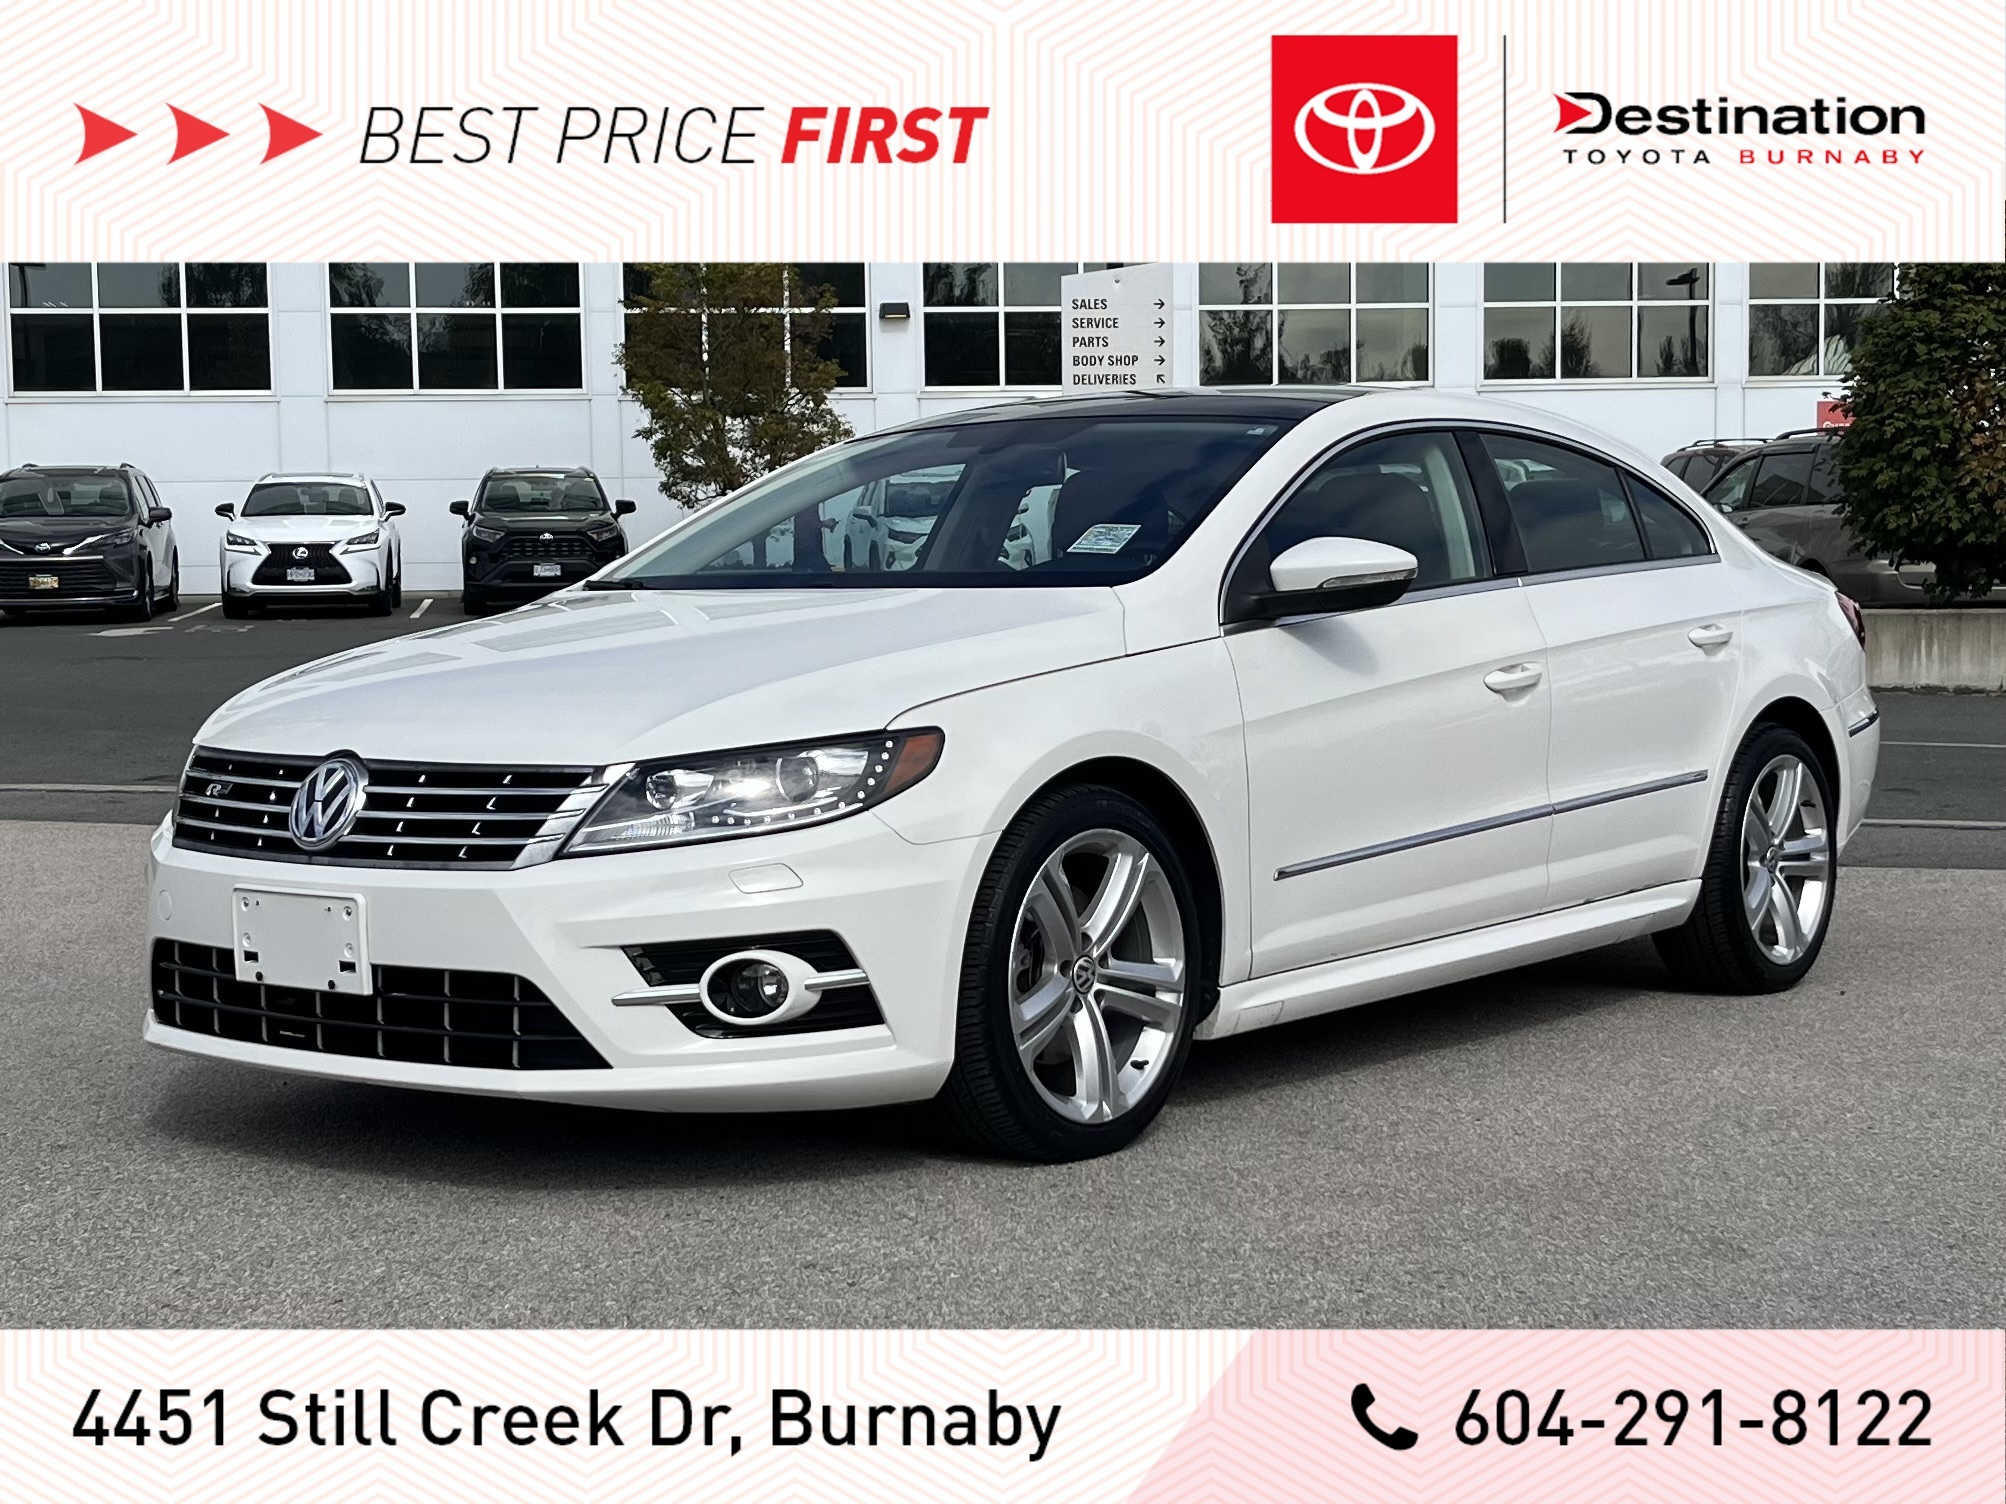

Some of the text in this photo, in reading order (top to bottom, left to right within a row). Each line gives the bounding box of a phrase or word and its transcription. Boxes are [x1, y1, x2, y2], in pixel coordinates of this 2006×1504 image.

[1071, 298, 1108, 310] SALES
[1071, 317, 1119, 329] SERVICE
[1072, 336, 1109, 348] PARTS
[1072, 354, 1139, 367] BODY SHOP
[1072, 373, 1137, 386] DELIVERIES
